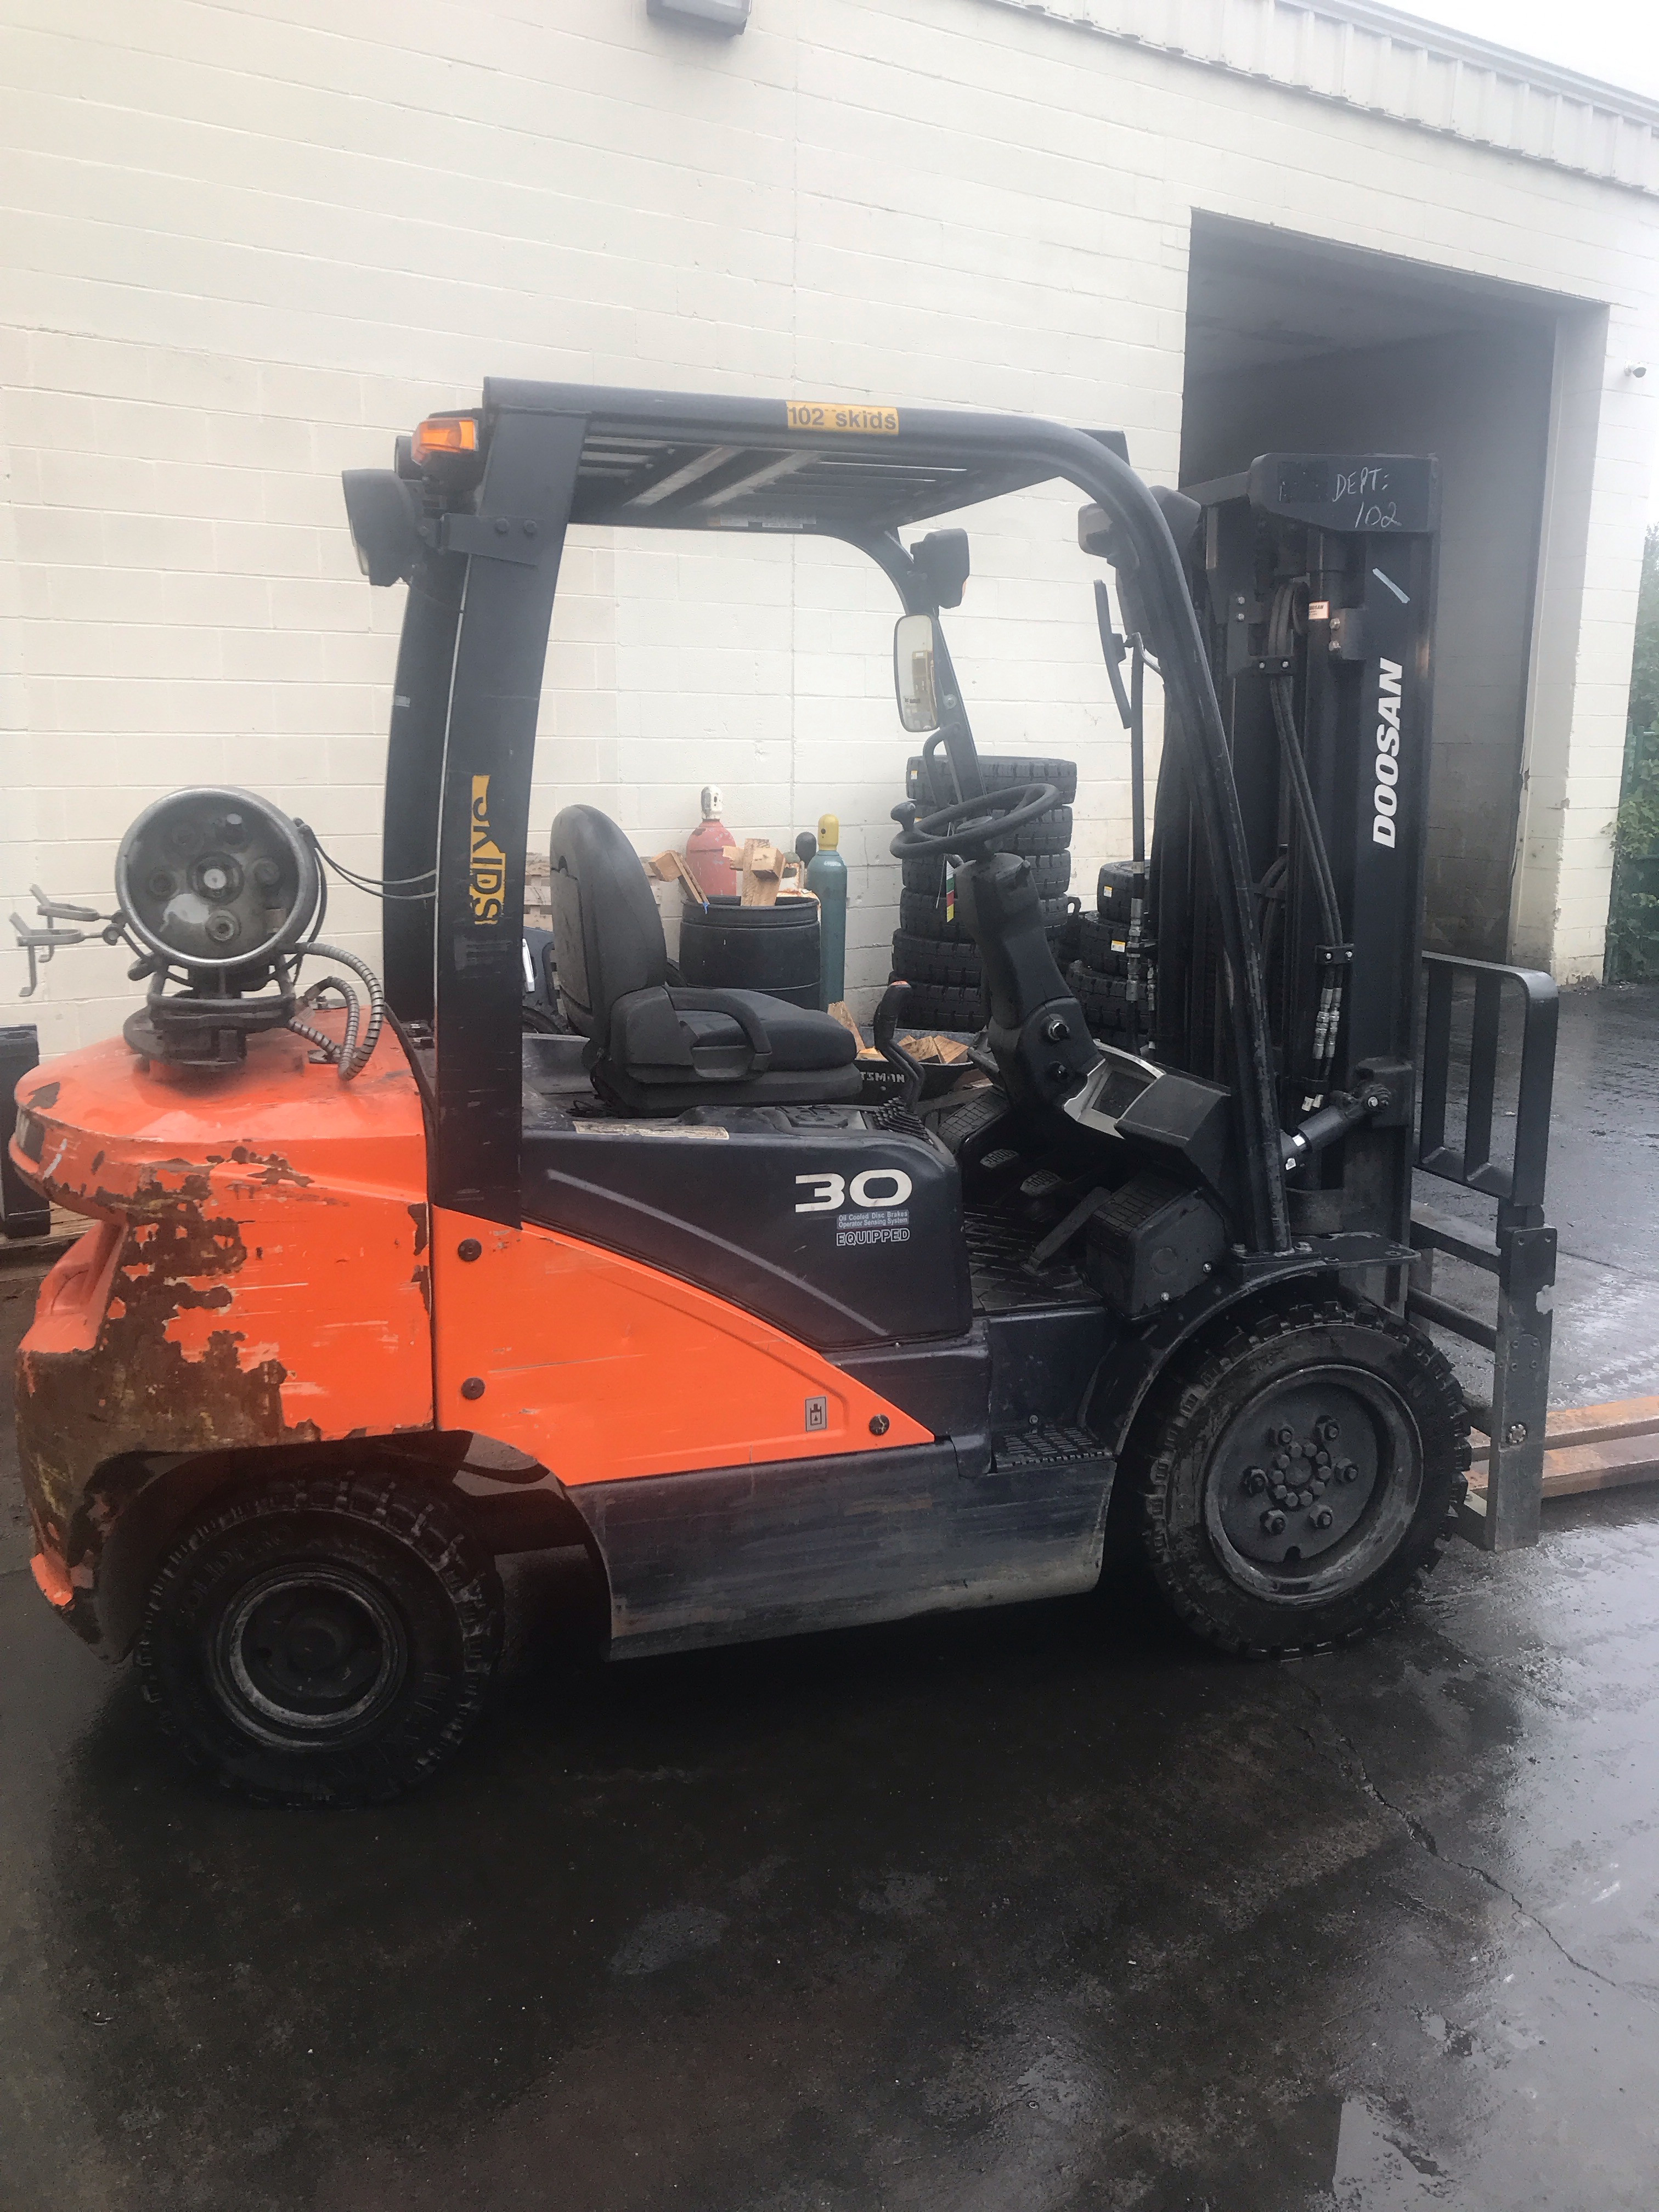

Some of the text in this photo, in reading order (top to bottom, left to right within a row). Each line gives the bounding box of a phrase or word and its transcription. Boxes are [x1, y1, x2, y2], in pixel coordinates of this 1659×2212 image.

[788, 405, 896, 430] 102 skids
[1333, 466, 1390, 502] DEPT:
[1355, 501, 1402, 528] 102
[1373, 657, 1403, 848] DOOSAN
[795, 1169, 912, 1212] 30
[887, 1217, 908, 1226] System
[836, 1228, 910, 1246] EQUIPPED
